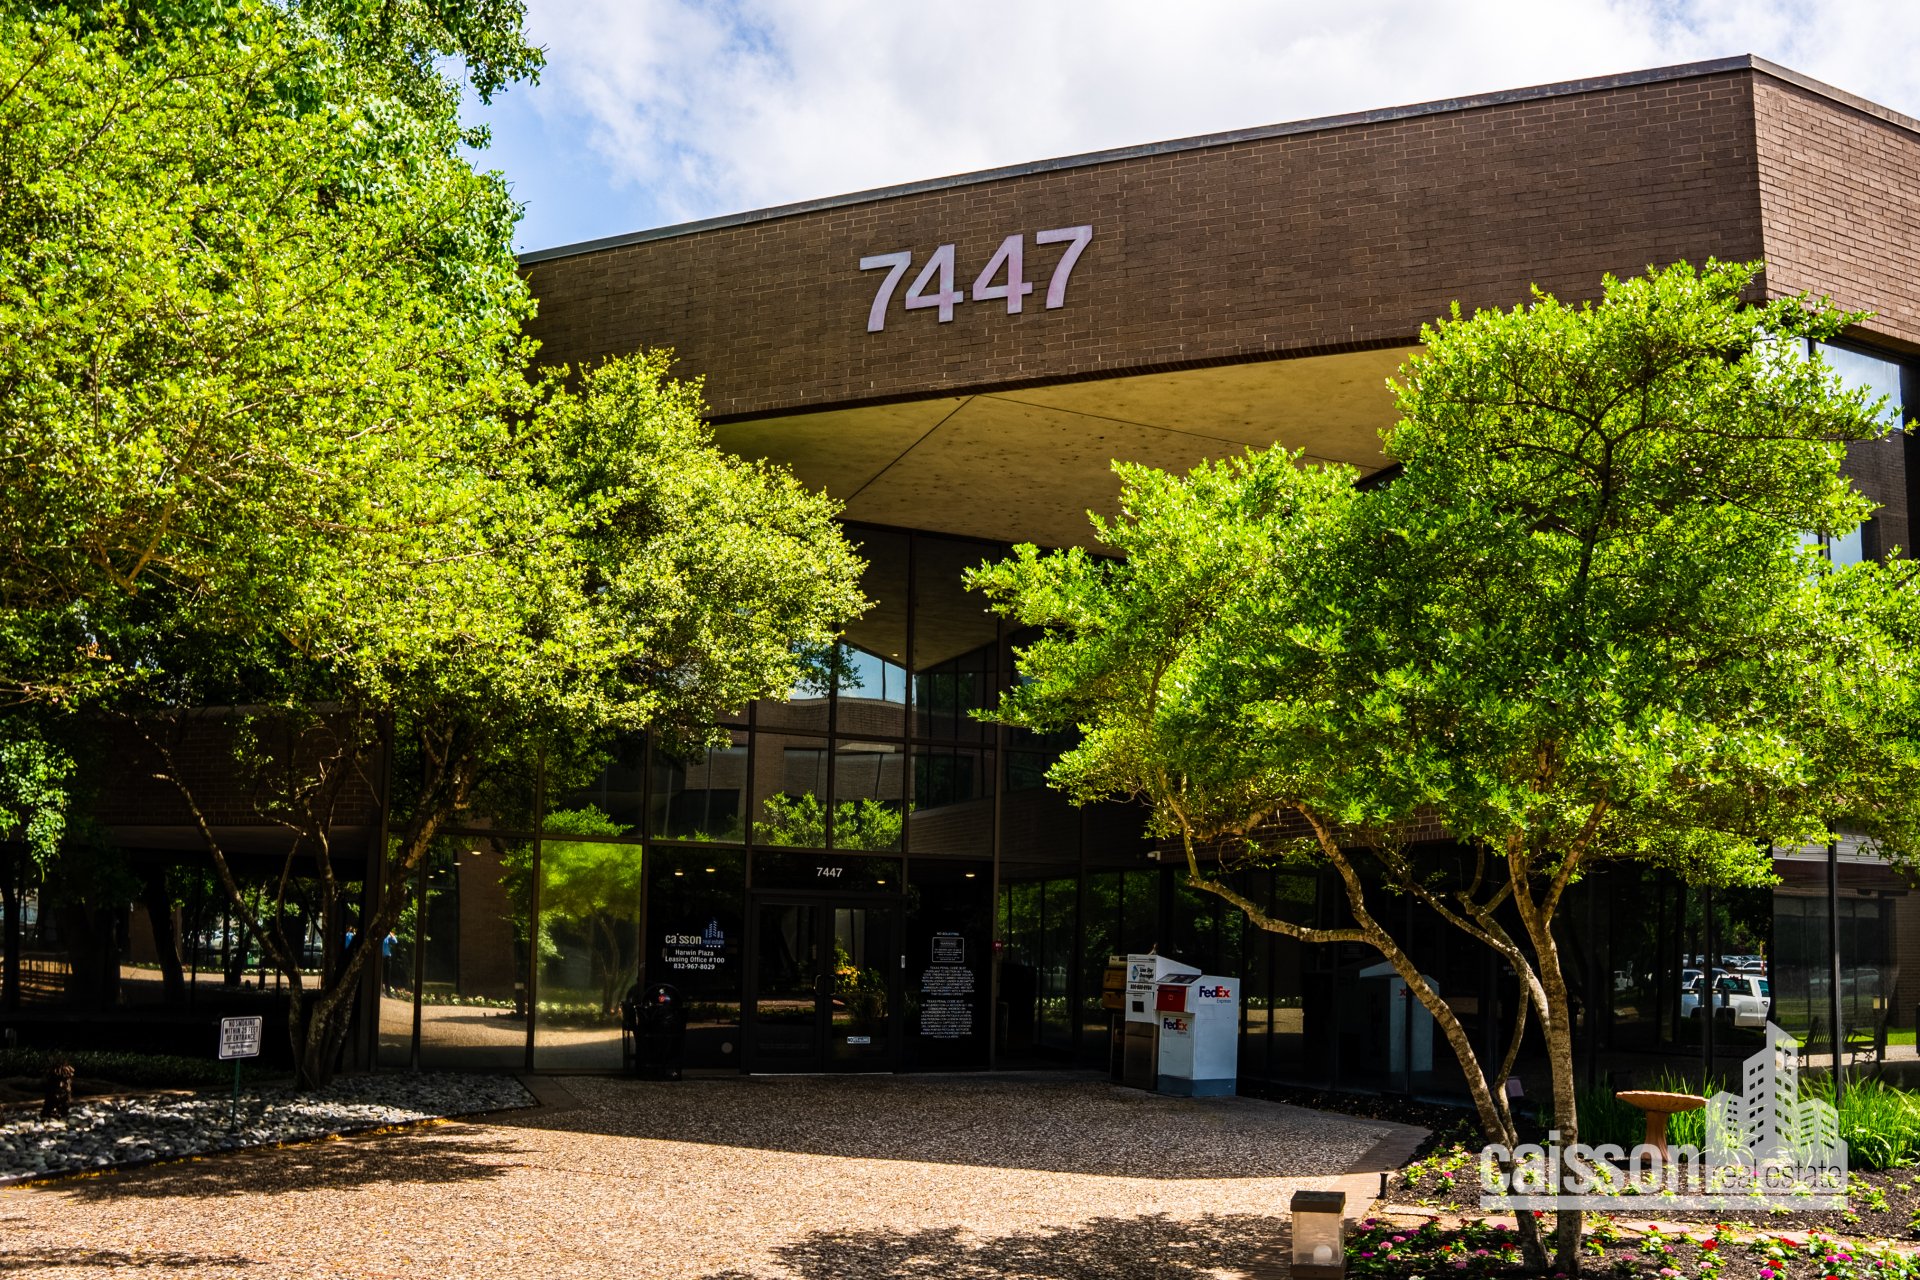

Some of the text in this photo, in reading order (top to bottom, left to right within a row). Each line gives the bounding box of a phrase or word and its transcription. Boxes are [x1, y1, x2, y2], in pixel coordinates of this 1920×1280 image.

[859, 224, 1093, 334] 7447
[816, 867, 843, 878] 7447
[665, 933, 702, 944] casson
[697, 949, 714, 957] Plaza
[1199, 986, 1231, 998] FedEx
[235, 1019, 256, 1027] SMOKING
[1163, 1017, 1188, 1031] FedEx
[225, 1027, 240, 1035] WITHIN
[241, 1026, 247, 1034] 25
[226, 1034, 232, 1042] OF
